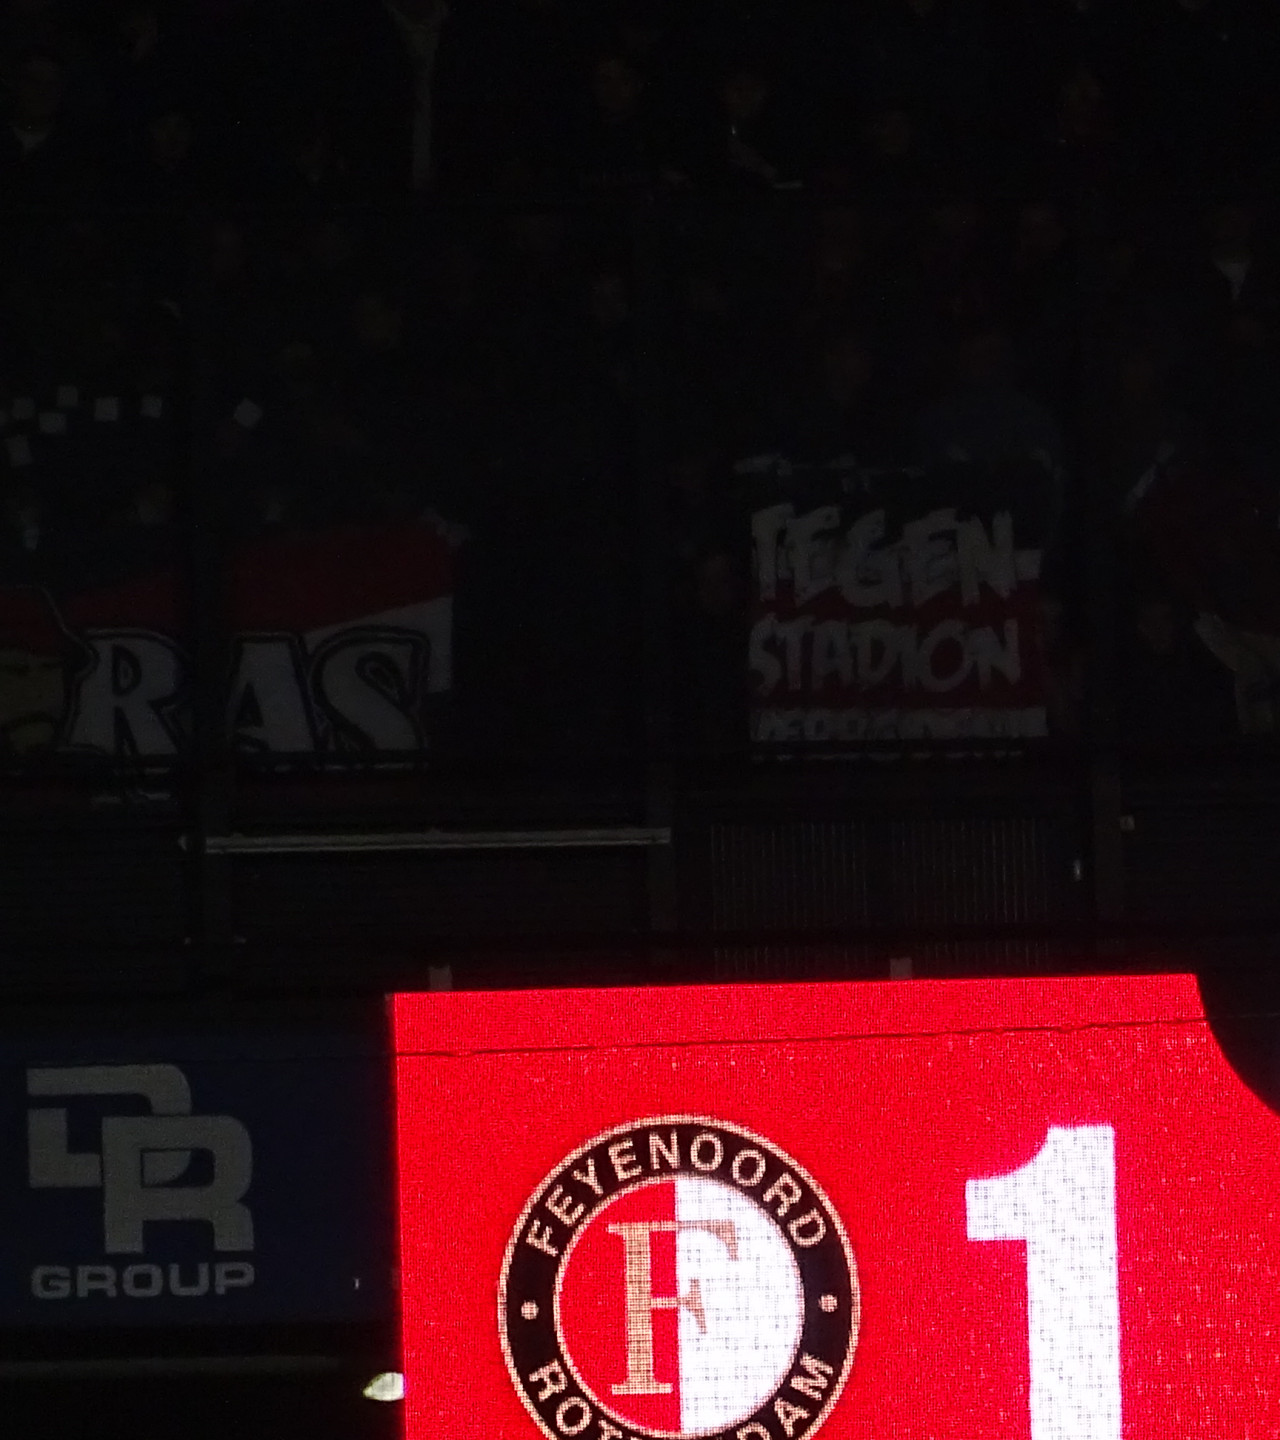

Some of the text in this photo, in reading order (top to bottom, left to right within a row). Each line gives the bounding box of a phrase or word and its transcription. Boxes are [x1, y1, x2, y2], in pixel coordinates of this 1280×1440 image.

[748, 612, 1022, 697] STADION
[526, 1132, 826, 1258] FEYENOORD
[31, 1262, 256, 1299] GROUP
